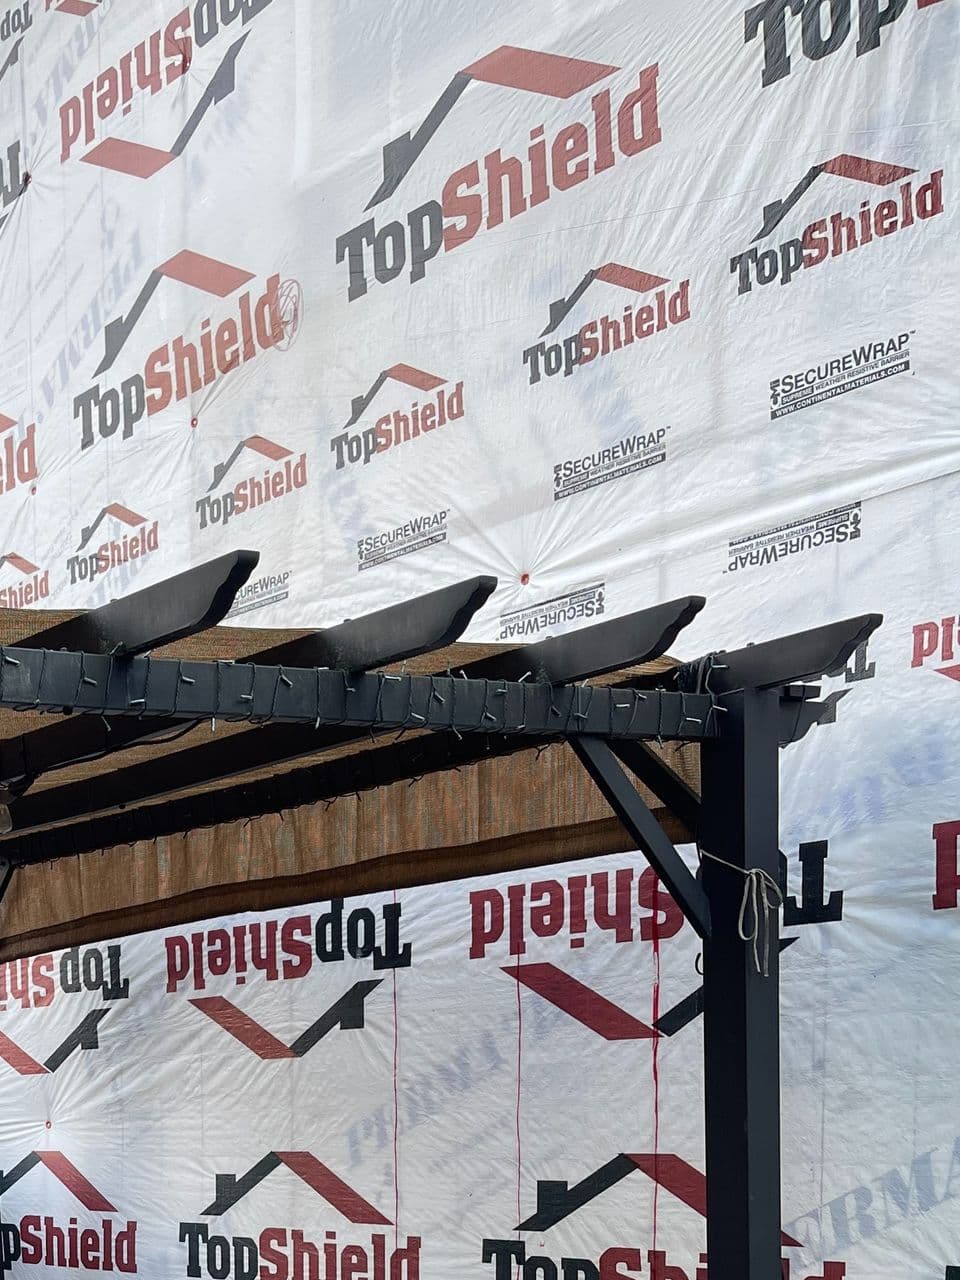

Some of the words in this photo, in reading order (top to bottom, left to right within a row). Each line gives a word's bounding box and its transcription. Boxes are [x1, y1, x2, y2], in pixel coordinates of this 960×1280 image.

[336, 62, 662, 303] TopShield
[730, 169, 945, 295] TopShield
[73, 273, 284, 451] TopShield
[523, 279, 690, 385] TopShield
[330, 381, 465, 471] TopShield
[196, 454, 309, 529] TopShield
[67, 521, 160, 585] TopShield
[165, 897, 412, 992] TopShield
[0, 1215, 137, 1274] pShield
